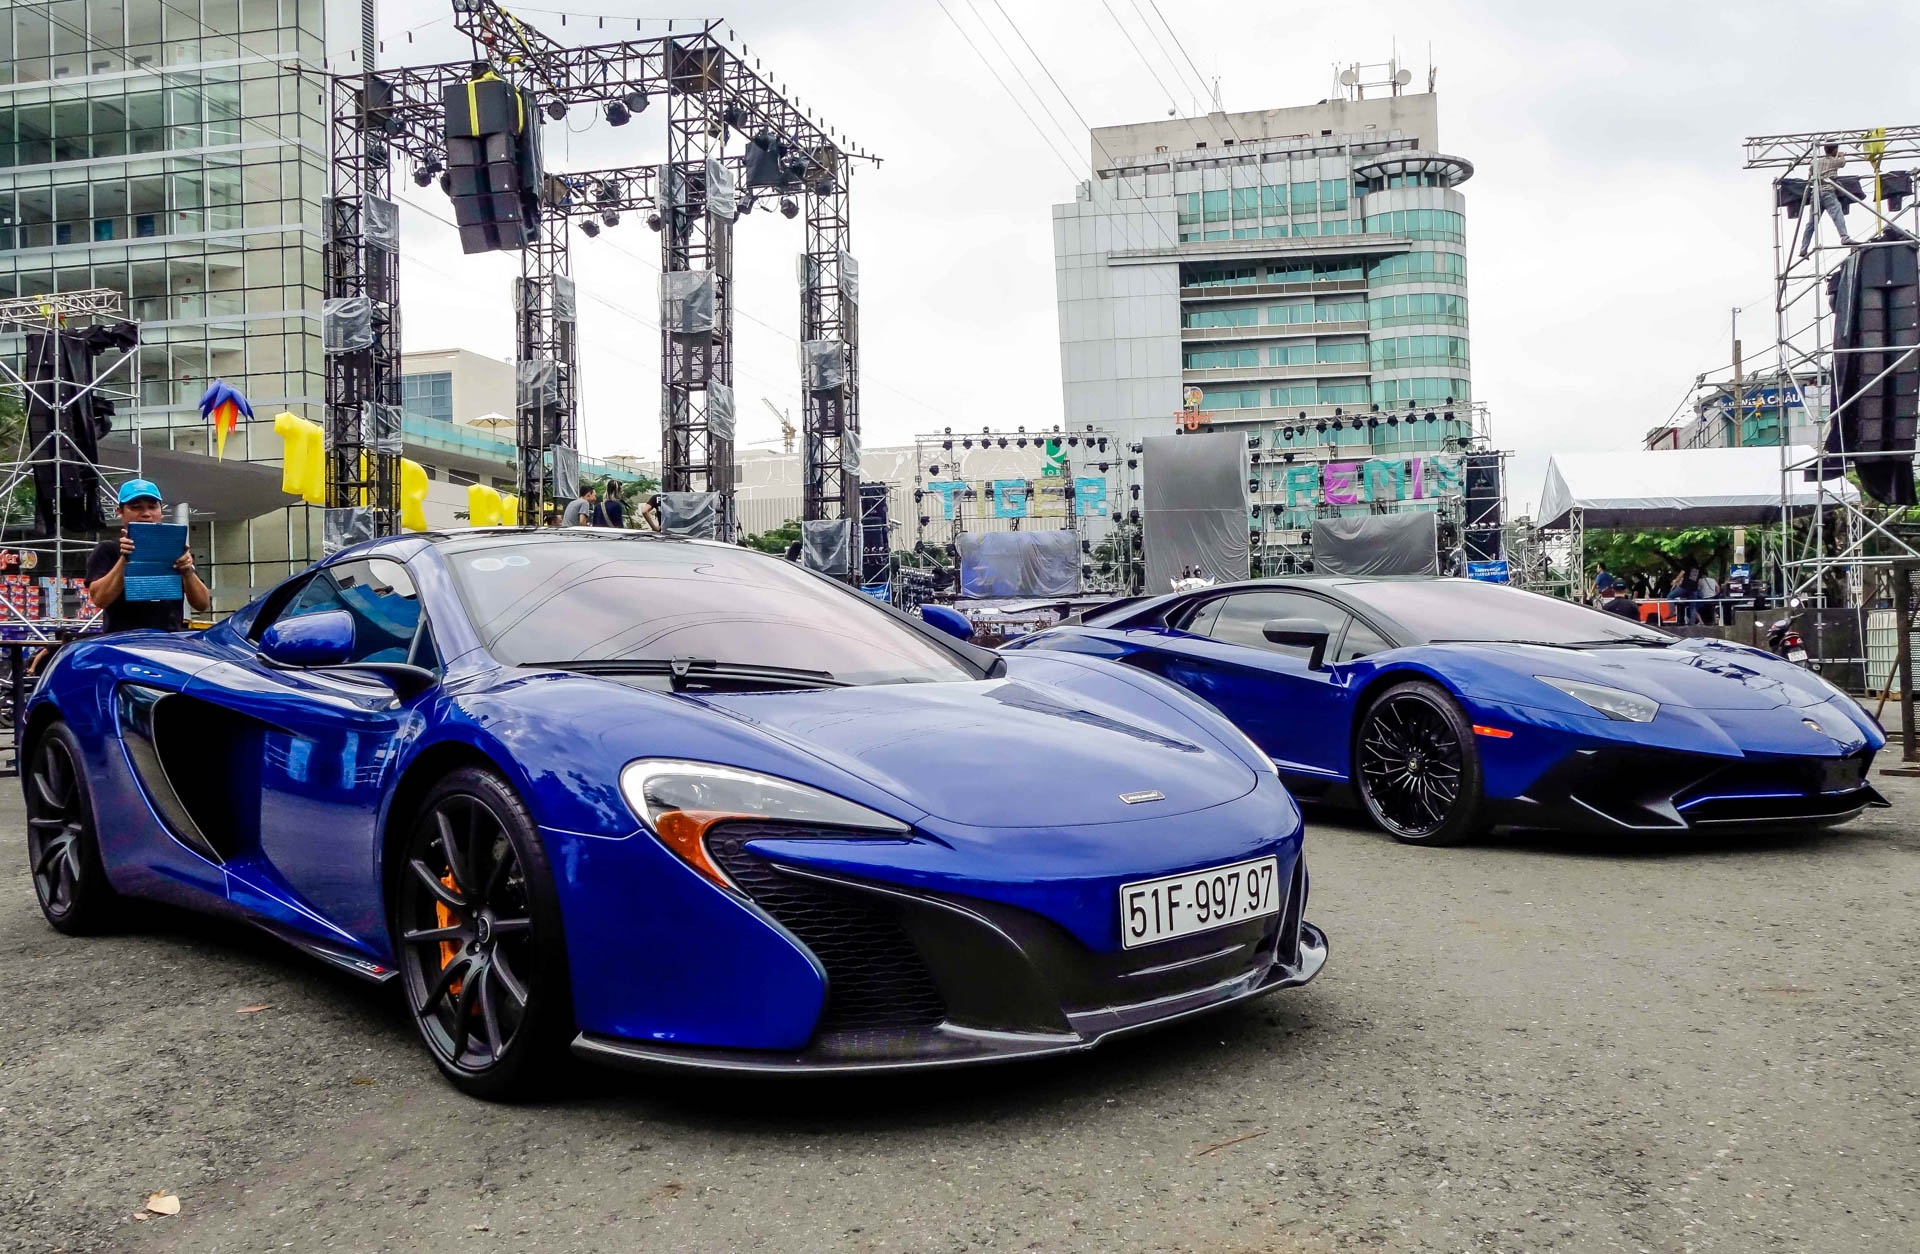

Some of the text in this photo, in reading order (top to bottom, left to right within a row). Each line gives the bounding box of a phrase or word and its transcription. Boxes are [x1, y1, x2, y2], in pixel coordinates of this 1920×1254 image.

[1173, 409, 1214, 431] Tiger
[928, 477, 1106, 520] TIGER
[1129, 865, 1273, 938] 51F-997.97
